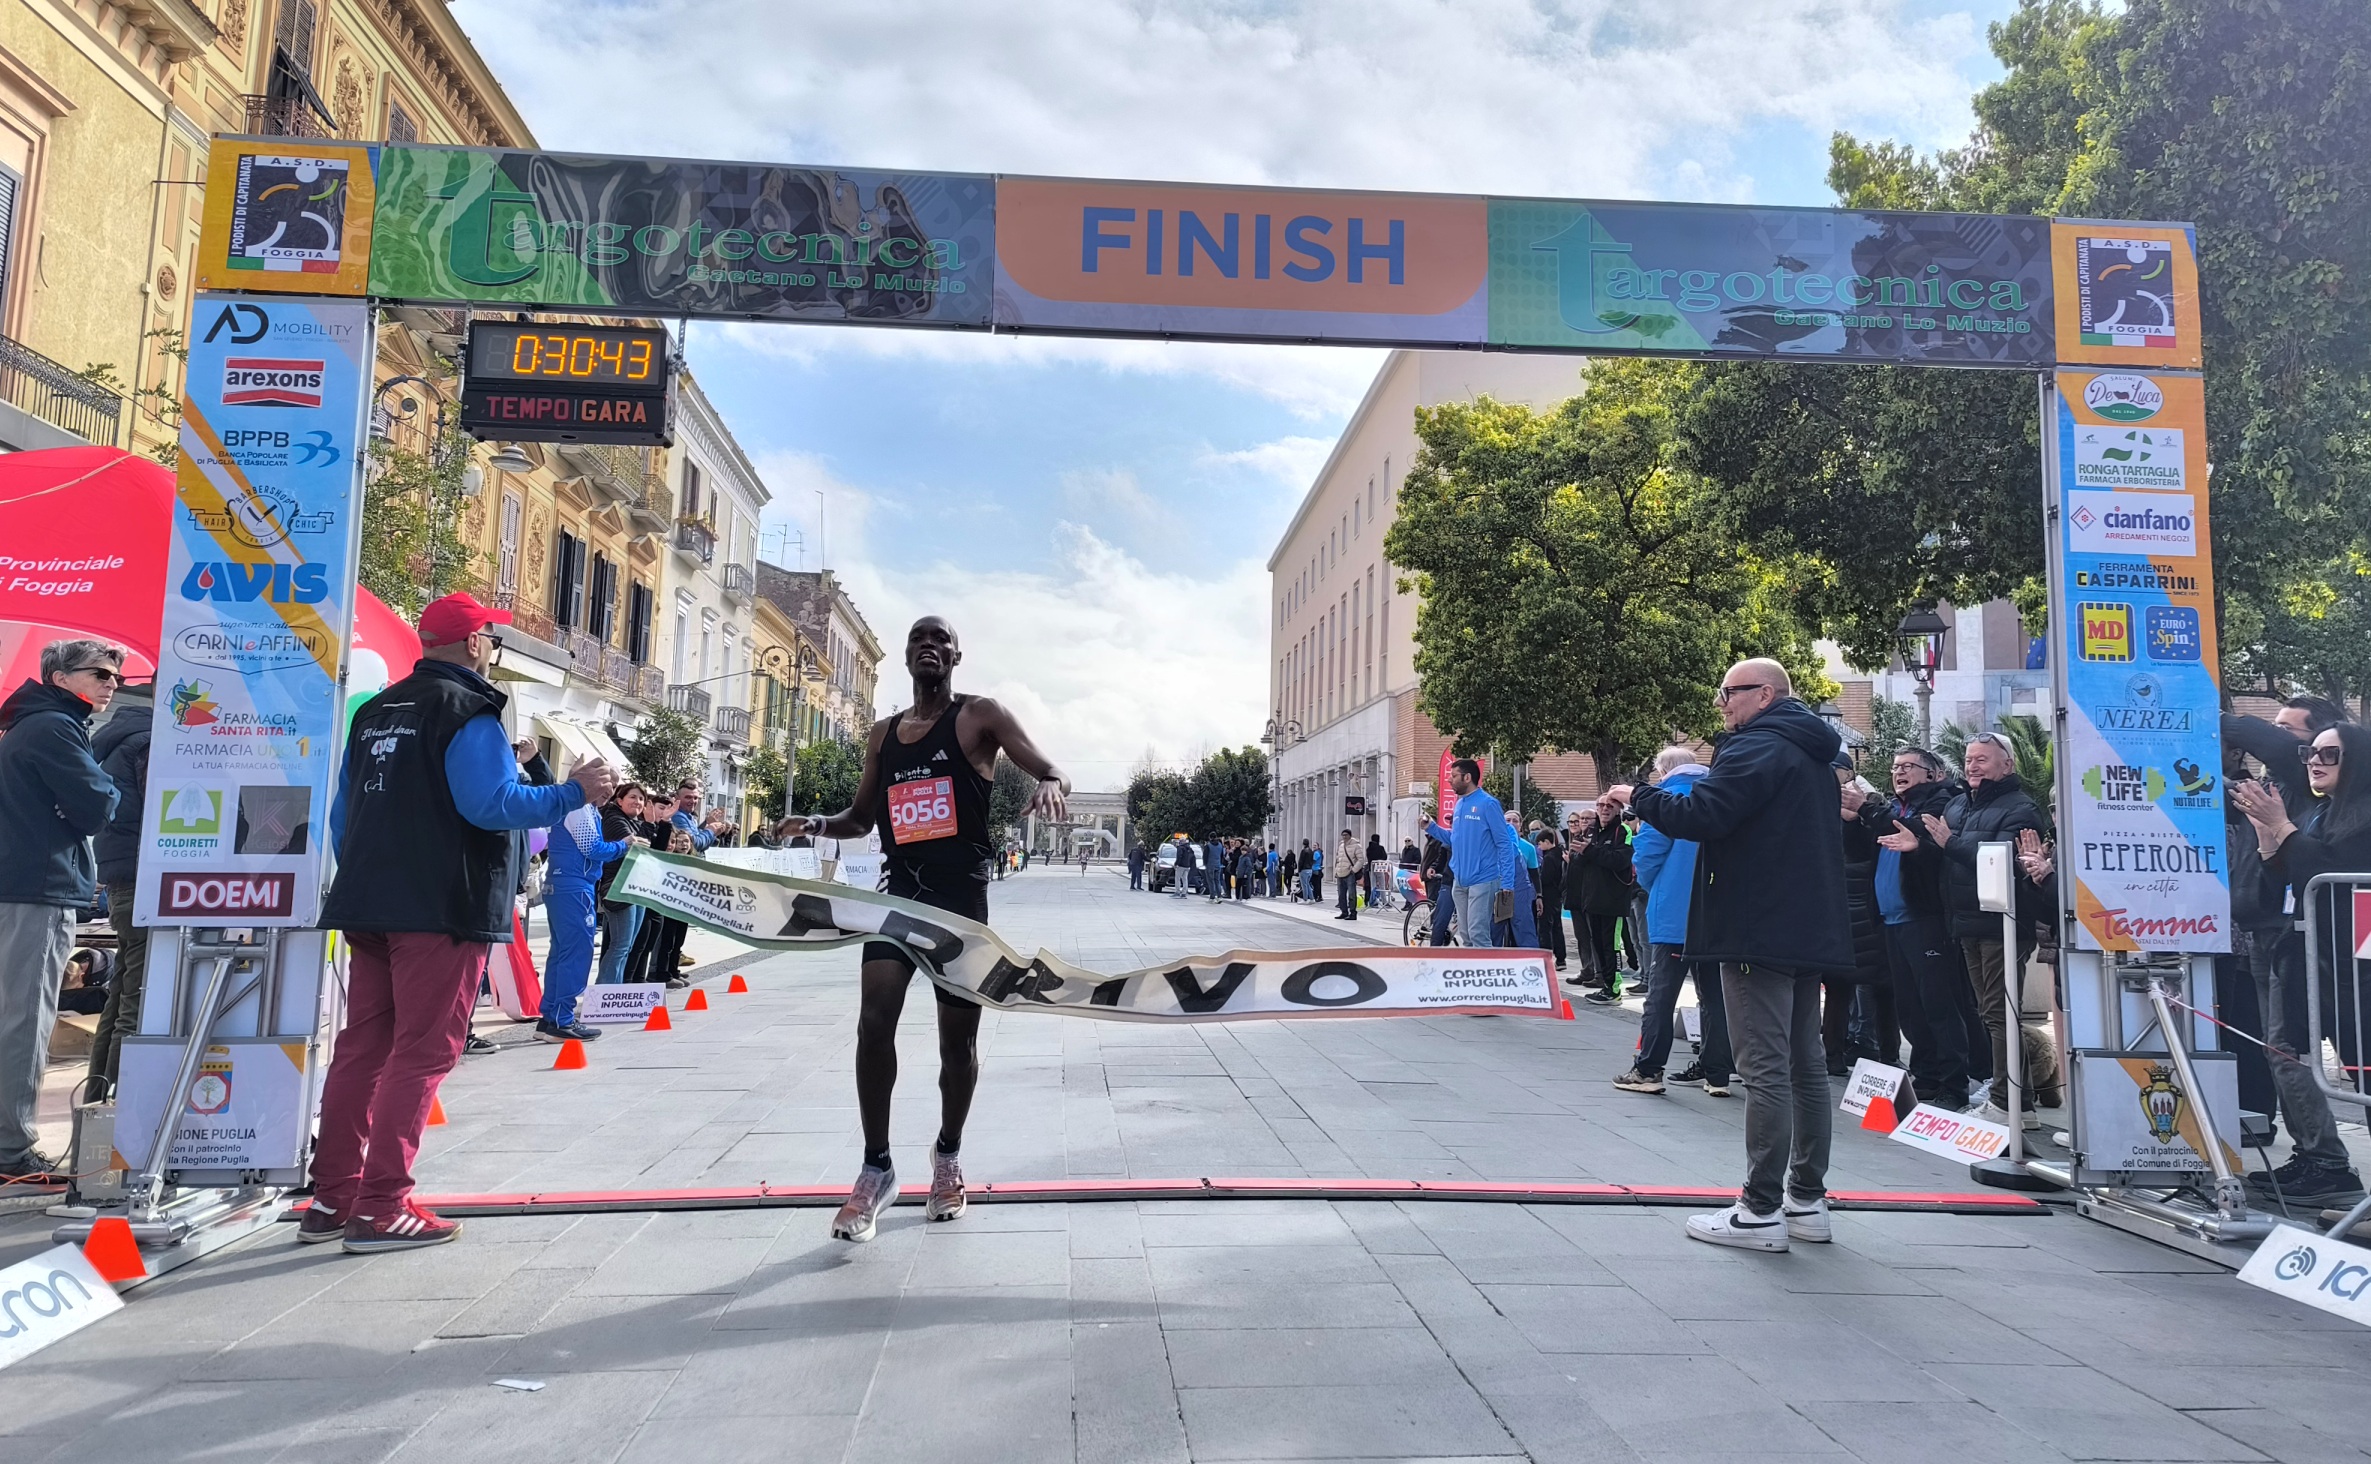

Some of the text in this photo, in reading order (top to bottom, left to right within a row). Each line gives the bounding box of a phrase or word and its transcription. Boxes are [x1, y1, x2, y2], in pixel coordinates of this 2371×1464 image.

[270, 157, 333, 167] A.S.D.
[237, 156, 253, 205] CAPITANATA
[236, 205, 247, 215] DI
[232, 215, 246, 250] PODISTI
[1082, 206, 1404, 285] FINISH
[2104, 240, 2157, 249] A.S.D.
[262, 249, 324, 259] FOGGIA
[2078, 238, 2090, 285] CAPITANATA
[686, 264, 966, 293] Gaetano Lo Muzio
[2080, 286, 2091, 295] DI
[2081, 295, 2092, 327] PODISTI
[203, 303, 352, 344] AD MOBILITY
[1773, 310, 2031, 334] Gaetano Lo Muzio
[2108, 326, 2162, 334] FOGGIA
[226, 371, 321, 388] arexons
[2090, 380, 2160, 405] De Luca
[486, 396, 647, 423] TEMPO GARA
[223, 430, 290, 447] BPPB
[2078, 464, 2180, 478] RONGA TARTAGLIA
[2079, 475, 2181, 486] FARMACIA ERBORISTERIA
[235, 485, 291, 504] BARBERSHOP
[204, 517, 317, 529] HAIR CHIC
[2103, 505, 2191, 531] cianfano
[2104, 532, 2190, 542] ARREDAMENTI NEGOZI
[0, 555, 125, 572] Provinciale
[2098, 562, 2174, 574] FERRAMENTA
[8, 577, 94, 596] Foggia
[180, 561, 329, 604] AVIS
[217, 621, 290, 630] supermercati
[2087, 620, 2124, 640] MD
[2160, 619, 2186, 630] EURO
[184, 633, 316, 652] CARNI e AFFINI
[2156, 628, 2191, 648] Spin
[224, 713, 297, 725] FARMACIA
[2098, 708, 2191, 730] NEREA
[210, 726, 297, 736] SANTA RITA.it
[175, 743, 253, 756] FARMACIA
[224, 762, 268, 770] FARMACIA
[270, 762, 303, 770] ONLINE
[2106, 765, 2142, 781] NEW
[2097, 802, 2126, 811] fitness
[2173, 797, 2212, 808] NUTRI LIFE
[891, 797, 950, 827] 5056
[157, 838, 218, 848] COLDIRETTI
[163, 850, 210, 858] FOGGIA
[2083, 842, 2219, 874] PEPERONE
[666, 871, 735, 897] CORRERE
[171, 880, 280, 909] DOEMI
[661, 878, 732, 912] IN PUGLIA
[628, 884, 754, 932] www.correreinpuglia.it
[2089, 908, 2217, 940] Tamma
[1442, 968, 1516, 980] CORRERE
[1444, 978, 1518, 988] IN PUGLIA
[602, 992, 645, 1001] CORRERE
[1418, 993, 1549, 1005] www.correreinpuglia.it
[601, 1001, 611, 1009] IN
[1861, 1073, 1888, 1090] CORRERE
[211, 1128, 256, 1139] PUGLIA
[1905, 1111, 2003, 1155] TEMPO GARA
[188, 1144, 193, 1153] il
[195, 1144, 241, 1154] patrocinio
[2132, 1146, 2199, 1157] Con il patrocinio
[181, 1156, 219, 1165] Regione
[221, 1155, 249, 1165] Puglia
[2122, 1159, 2211, 1170] del Comune di Foggia
